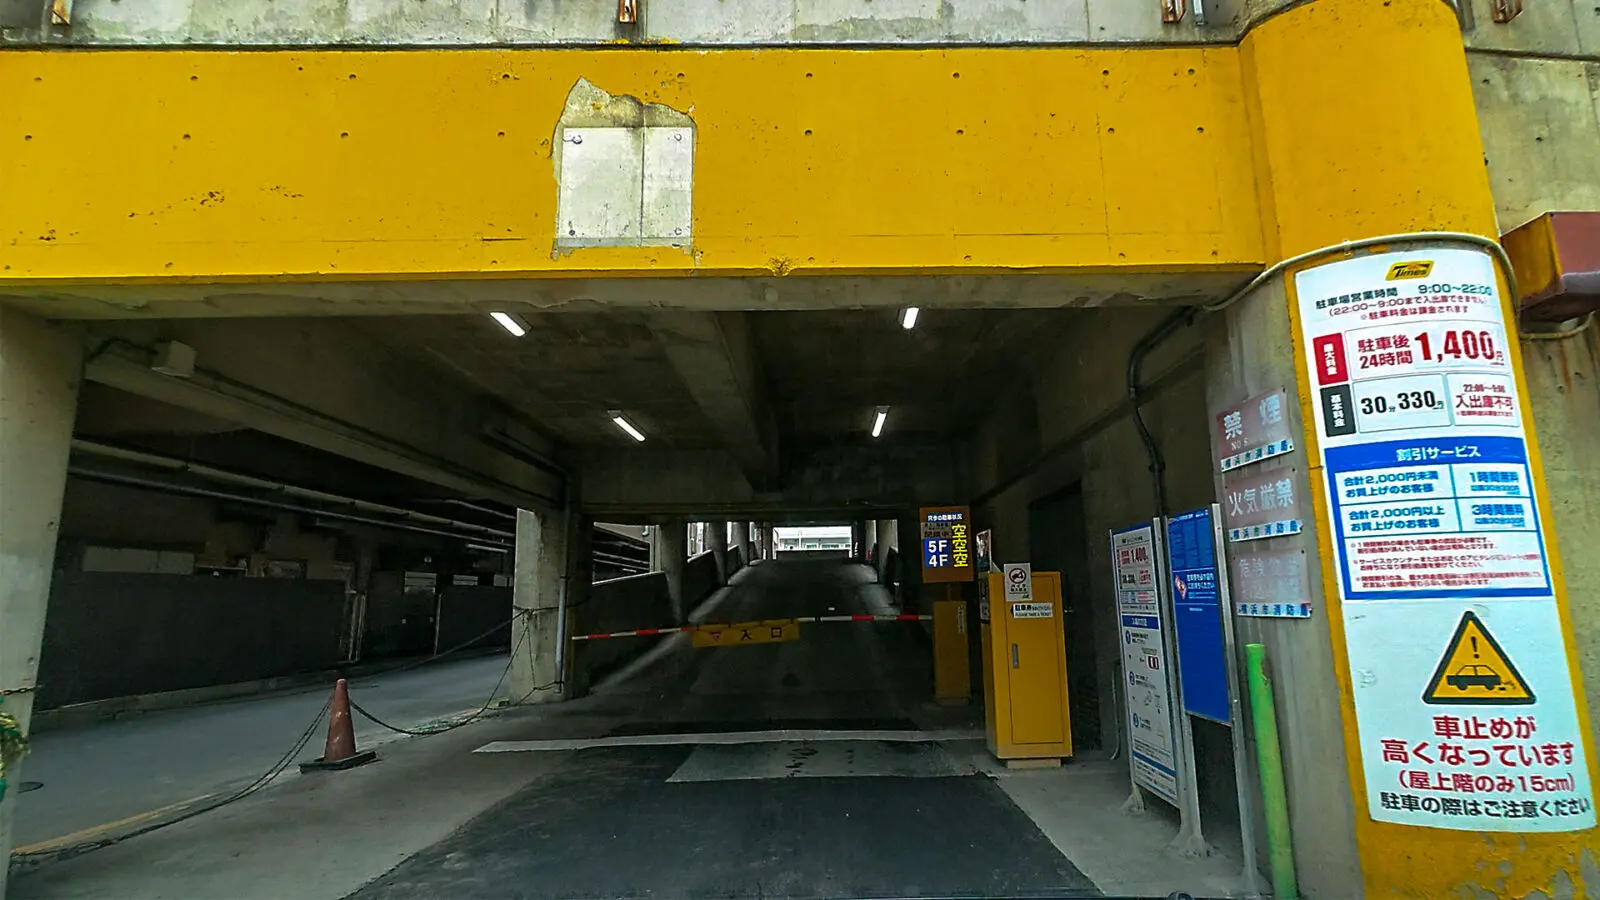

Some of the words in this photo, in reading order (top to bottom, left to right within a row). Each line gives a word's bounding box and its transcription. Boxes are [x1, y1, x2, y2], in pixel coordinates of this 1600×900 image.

[1393, 263, 1430, 278] Times
[1316, 287, 1398, 310] 駐車場営業時間
[1357, 334, 1410, 353] 駐車後
[1359, 350, 1413, 369] 24時間
[1330, 393, 1346, 428] 基本料金
[1396, 446, 1481, 462] 割引サービス
[1229, 478, 1294, 517] 火気厳禁
[1345, 484, 1435, 498] お買上げのお客様
[1349, 506, 1446, 521] 合計2,000円以上
[951, 523, 967, 538] 空
[1350, 518, 1441, 532] お買上げのお客様
[928, 540, 947, 553] 5F
[952, 539, 968, 553] 空
[929, 554, 948, 568] 4F
[953, 553, 969, 568] 空
[740, 627, 783, 640] 入口
[1432, 715, 1536, 740] 車止めが
[1380, 739, 1574, 767] 高くなっています
[1399, 770, 1574, 794] (屋上階のみ15cm)
[1380, 792, 1591, 818] 駐車の際はご注意ください
